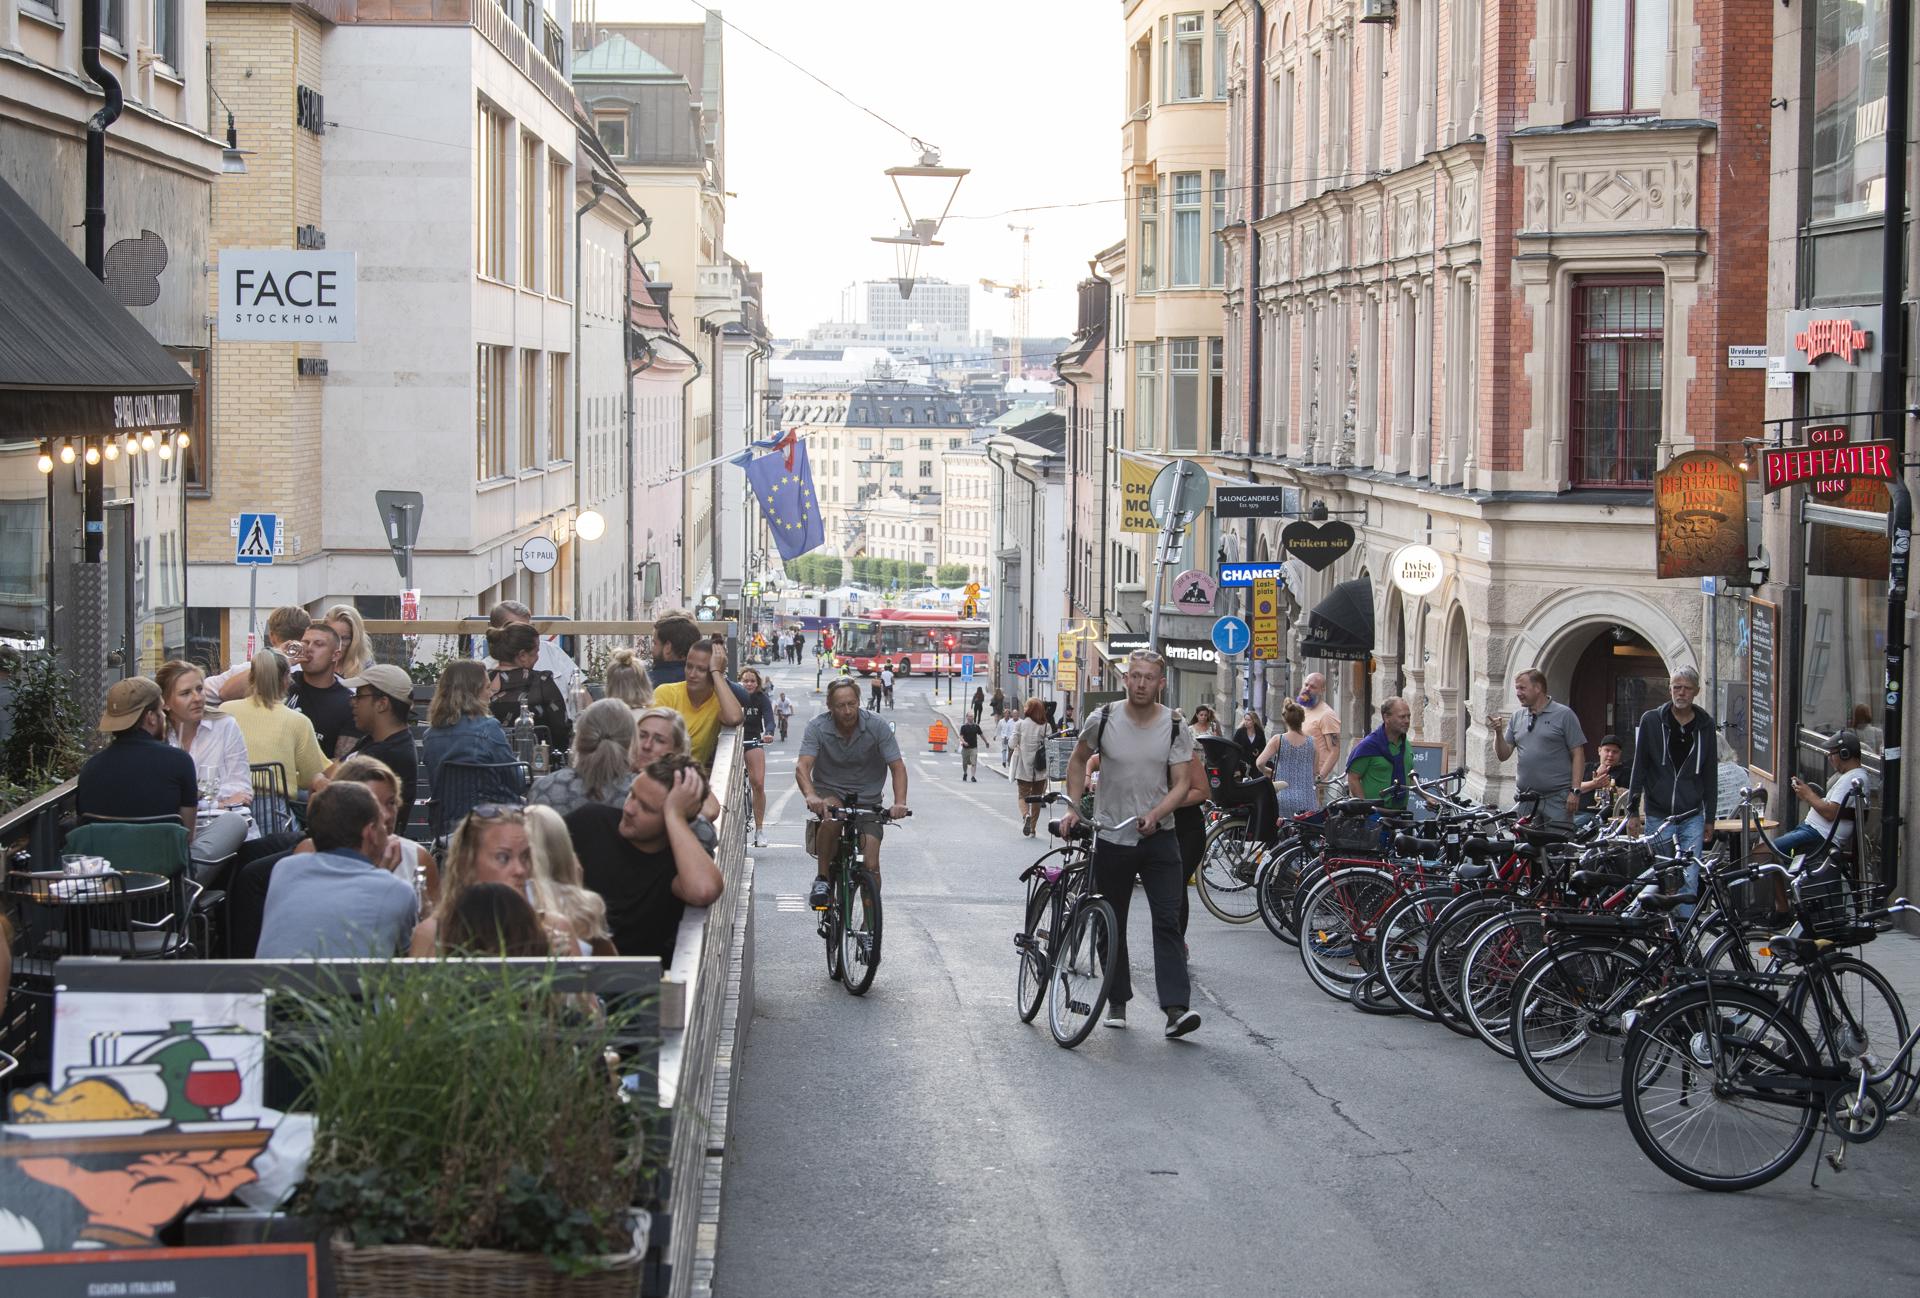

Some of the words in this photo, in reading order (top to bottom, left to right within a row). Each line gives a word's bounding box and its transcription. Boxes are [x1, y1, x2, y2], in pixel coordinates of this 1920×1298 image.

[236, 269, 337, 307] FACE
[235, 313, 338, 324] STOCKHOLM
[1794, 331, 1809, 352] OLD
[1807, 319, 1854, 366] BEEFEATER
[1852, 330, 1867, 350] INN
[1811, 429, 1845, 443] OLD
[1681, 462, 1719, 474] OLD
[1767, 445, 1892, 488] BEEFEATER
[1126, 483, 1151, 495] CH
[1660, 473, 1739, 496] BEEFEATER
[1817, 479, 1845, 493] INN
[1682, 489, 1719, 503] INN
[1126, 499, 1150, 512] MO
[1125, 517, 1160, 528] CHA
[1289, 538, 1328, 548] fröken
[1330, 538, 1349, 548] söt
[536, 551, 554, 560] PAUL
[1402, 570, 1435, 582] tango
[1256, 589, 1274, 597] plats
[1320, 648, 1334, 658] Du
